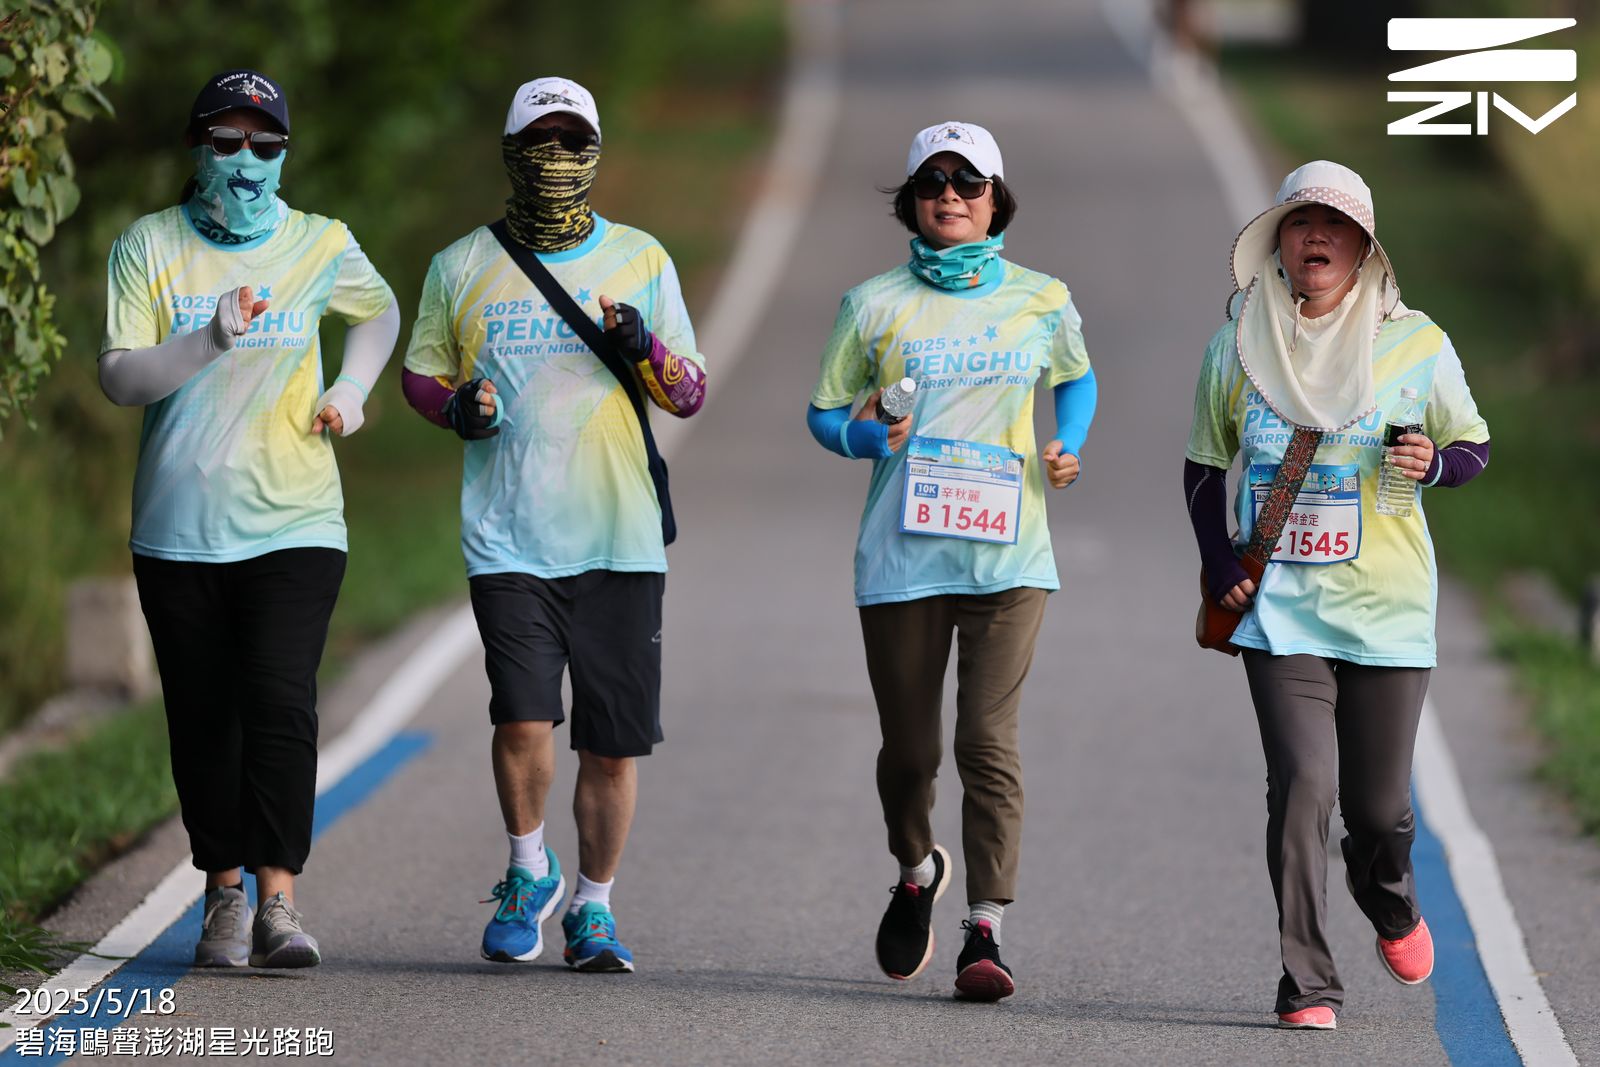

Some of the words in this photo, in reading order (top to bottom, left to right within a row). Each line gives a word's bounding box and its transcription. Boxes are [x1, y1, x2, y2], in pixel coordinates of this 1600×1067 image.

[217, 73, 248, 88] AIRCRAFT
[171, 294, 217, 309] 2025
[482, 299, 533, 318] 2025
[281, 336, 305, 347] RUN
[901, 337, 946, 355] 2025
[488, 344, 543, 357] STARRY
[905, 350, 1032, 378] PENGHU
[915, 378, 955, 391] TARRY
[958, 375, 1002, 387] NIGHT
[1005, 375, 1029, 387] RUN
[1246, 392, 1265, 407] 20
[1244, 432, 1292, 448] STARRY
[1348, 433, 1381, 448] RUN
[917, 484, 937, 495] 10K
[941, 486, 980, 504] 辛秋麗
[916, 503, 931, 525] B
[941, 503, 1007, 536] 1544
[1288, 512, 1320, 527] 蔡金定
[1289, 530, 1350, 557] 1545
